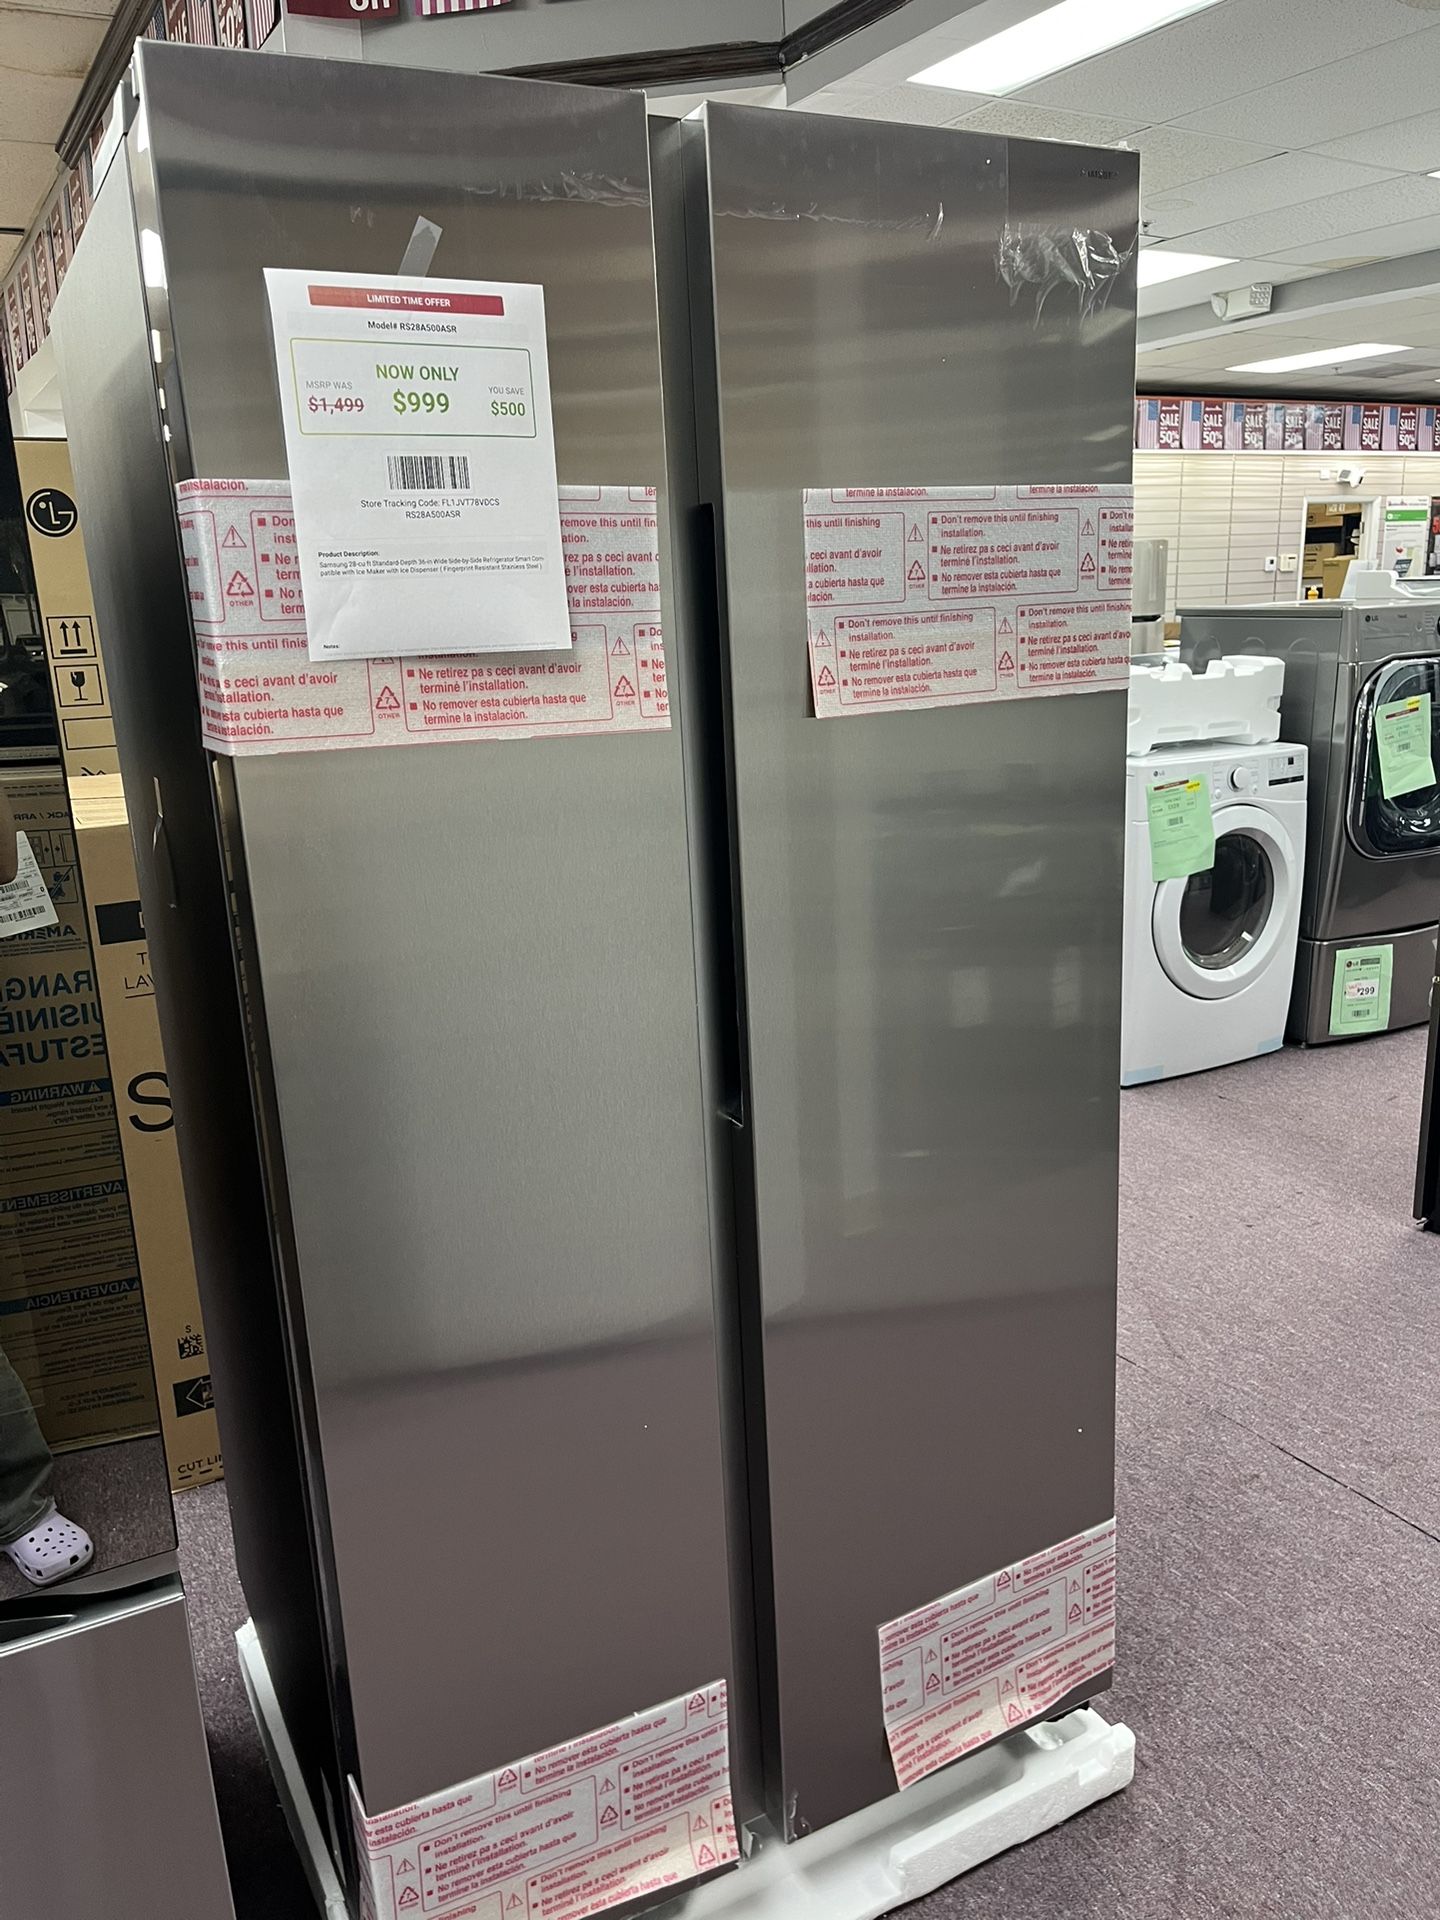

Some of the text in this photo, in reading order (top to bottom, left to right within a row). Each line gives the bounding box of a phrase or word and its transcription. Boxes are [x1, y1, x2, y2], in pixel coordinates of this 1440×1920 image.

[366, 294, 451, 307] LIMITED TIME OFFER
[367, 320, 457, 333] Model# RS28A500ASR
[375, 364, 460, 382] NOW ONLY
[305, 380, 353, 391] MSRP WAS
[487, 386, 525, 396] YOU SAVE
[307, 395, 365, 415] $1,499
[392, 388, 450, 415] $999
[490, 400, 526, 417] $500
[1160, 413, 1179, 427] SALE
[1203, 413, 1223, 427] SALE
[1245, 414, 1263, 428] SALE
[1324, 416, 1341, 429] SALE
[1363, 417, 1379, 430] SALE
[1400, 418, 1416, 431] SALE
[360, 499, 382, 508] Store
[383, 499, 417, 509] Tracking
[417, 499, 440, 507] Code:
[405, 510, 461, 519] RS28A500ASR
[600, 517, 642, 528] this until
[604, 551, 653, 562] ceci avant
[573, 565, 636, 577] l'installation.
[589, 582, 647, 594] esta cubierta
[229, 599, 254, 608] OTHER
[572, 597, 581, 608] la
[848, 612, 973, 629] Don't remove this until finishing
[848, 631, 896, 643] installation.
[226, 639, 278, 651] this until
[848, 650, 860, 660] Ne
[862, 648, 887, 659] retirez
[907, 645, 924, 655] ceci
[926, 644, 947, 655] avant
[948, 641, 975, 652] d'avoir
[418, 662, 582, 680] Ne retirez pa s ceci avant d'avoir
[851, 668, 978, 687] No remover esta cubierta hasta que
[234, 675, 259, 688] ceci
[263, 676, 295, 687] avant
[298, 672, 338, 685] d'avoir
[463, 679, 529, 692] l'installation.
[853, 688, 881, 699] termine
[882, 686, 889, 696] la
[423, 693, 587, 711] No remover esta cubierta hasta que
[243, 706, 343, 721] cubierta hasta que
[424, 713, 461, 725] termine
[463, 712, 472, 723] la
[177, 1459, 204, 1474] CUT
[434, 1788, 572, 1848] Don't remove this until finishing
[434, 1810, 575, 1872] Ne retirez ceci avant d'avoir
